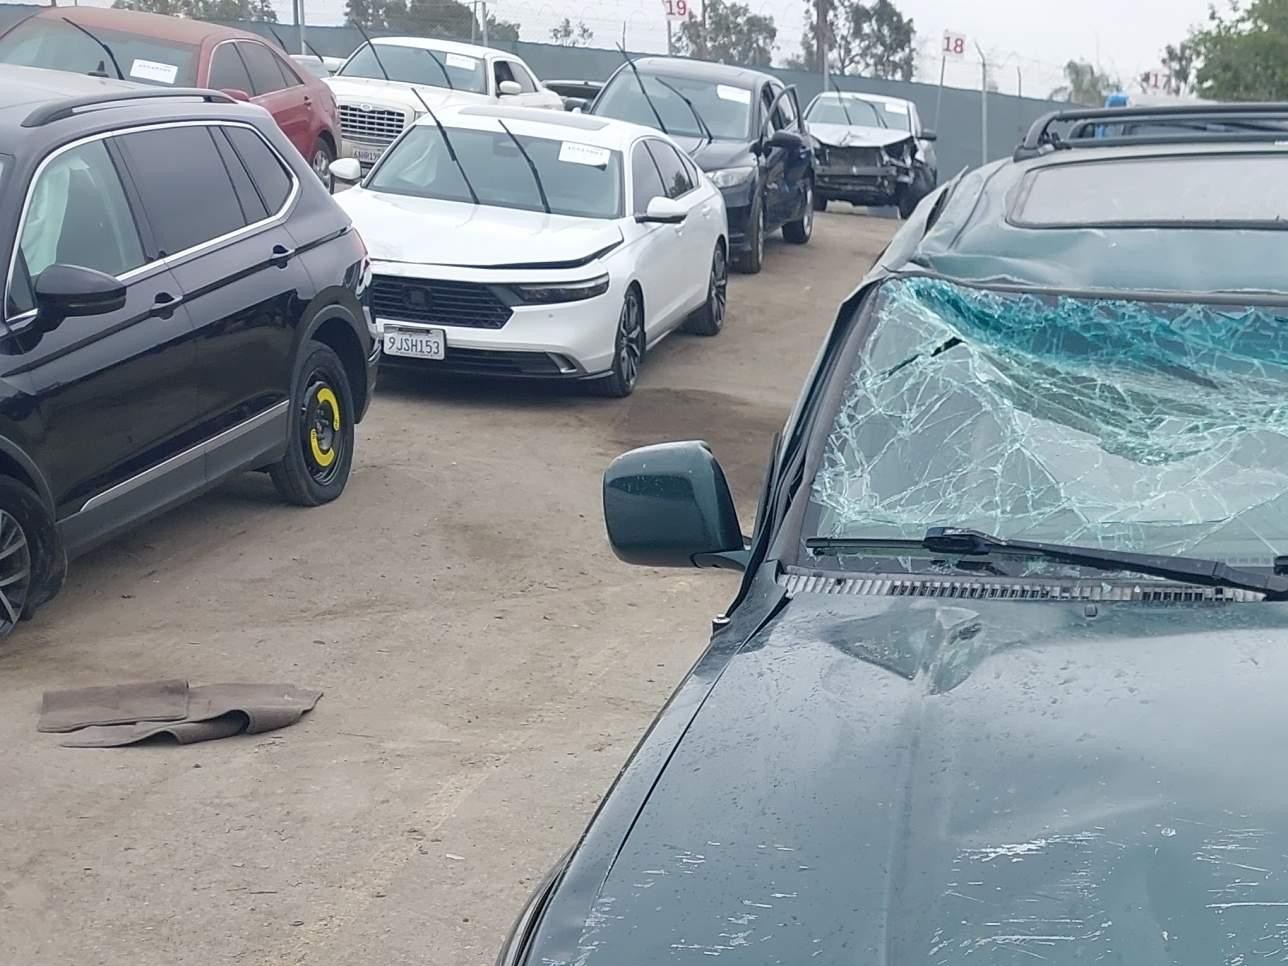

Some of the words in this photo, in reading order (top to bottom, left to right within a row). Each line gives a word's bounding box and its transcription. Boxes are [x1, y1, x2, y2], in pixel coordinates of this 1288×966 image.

[666, 0, 687, 16] 19
[943, 36, 965, 54] 18
[388, 336, 440, 355] 9JSH153
